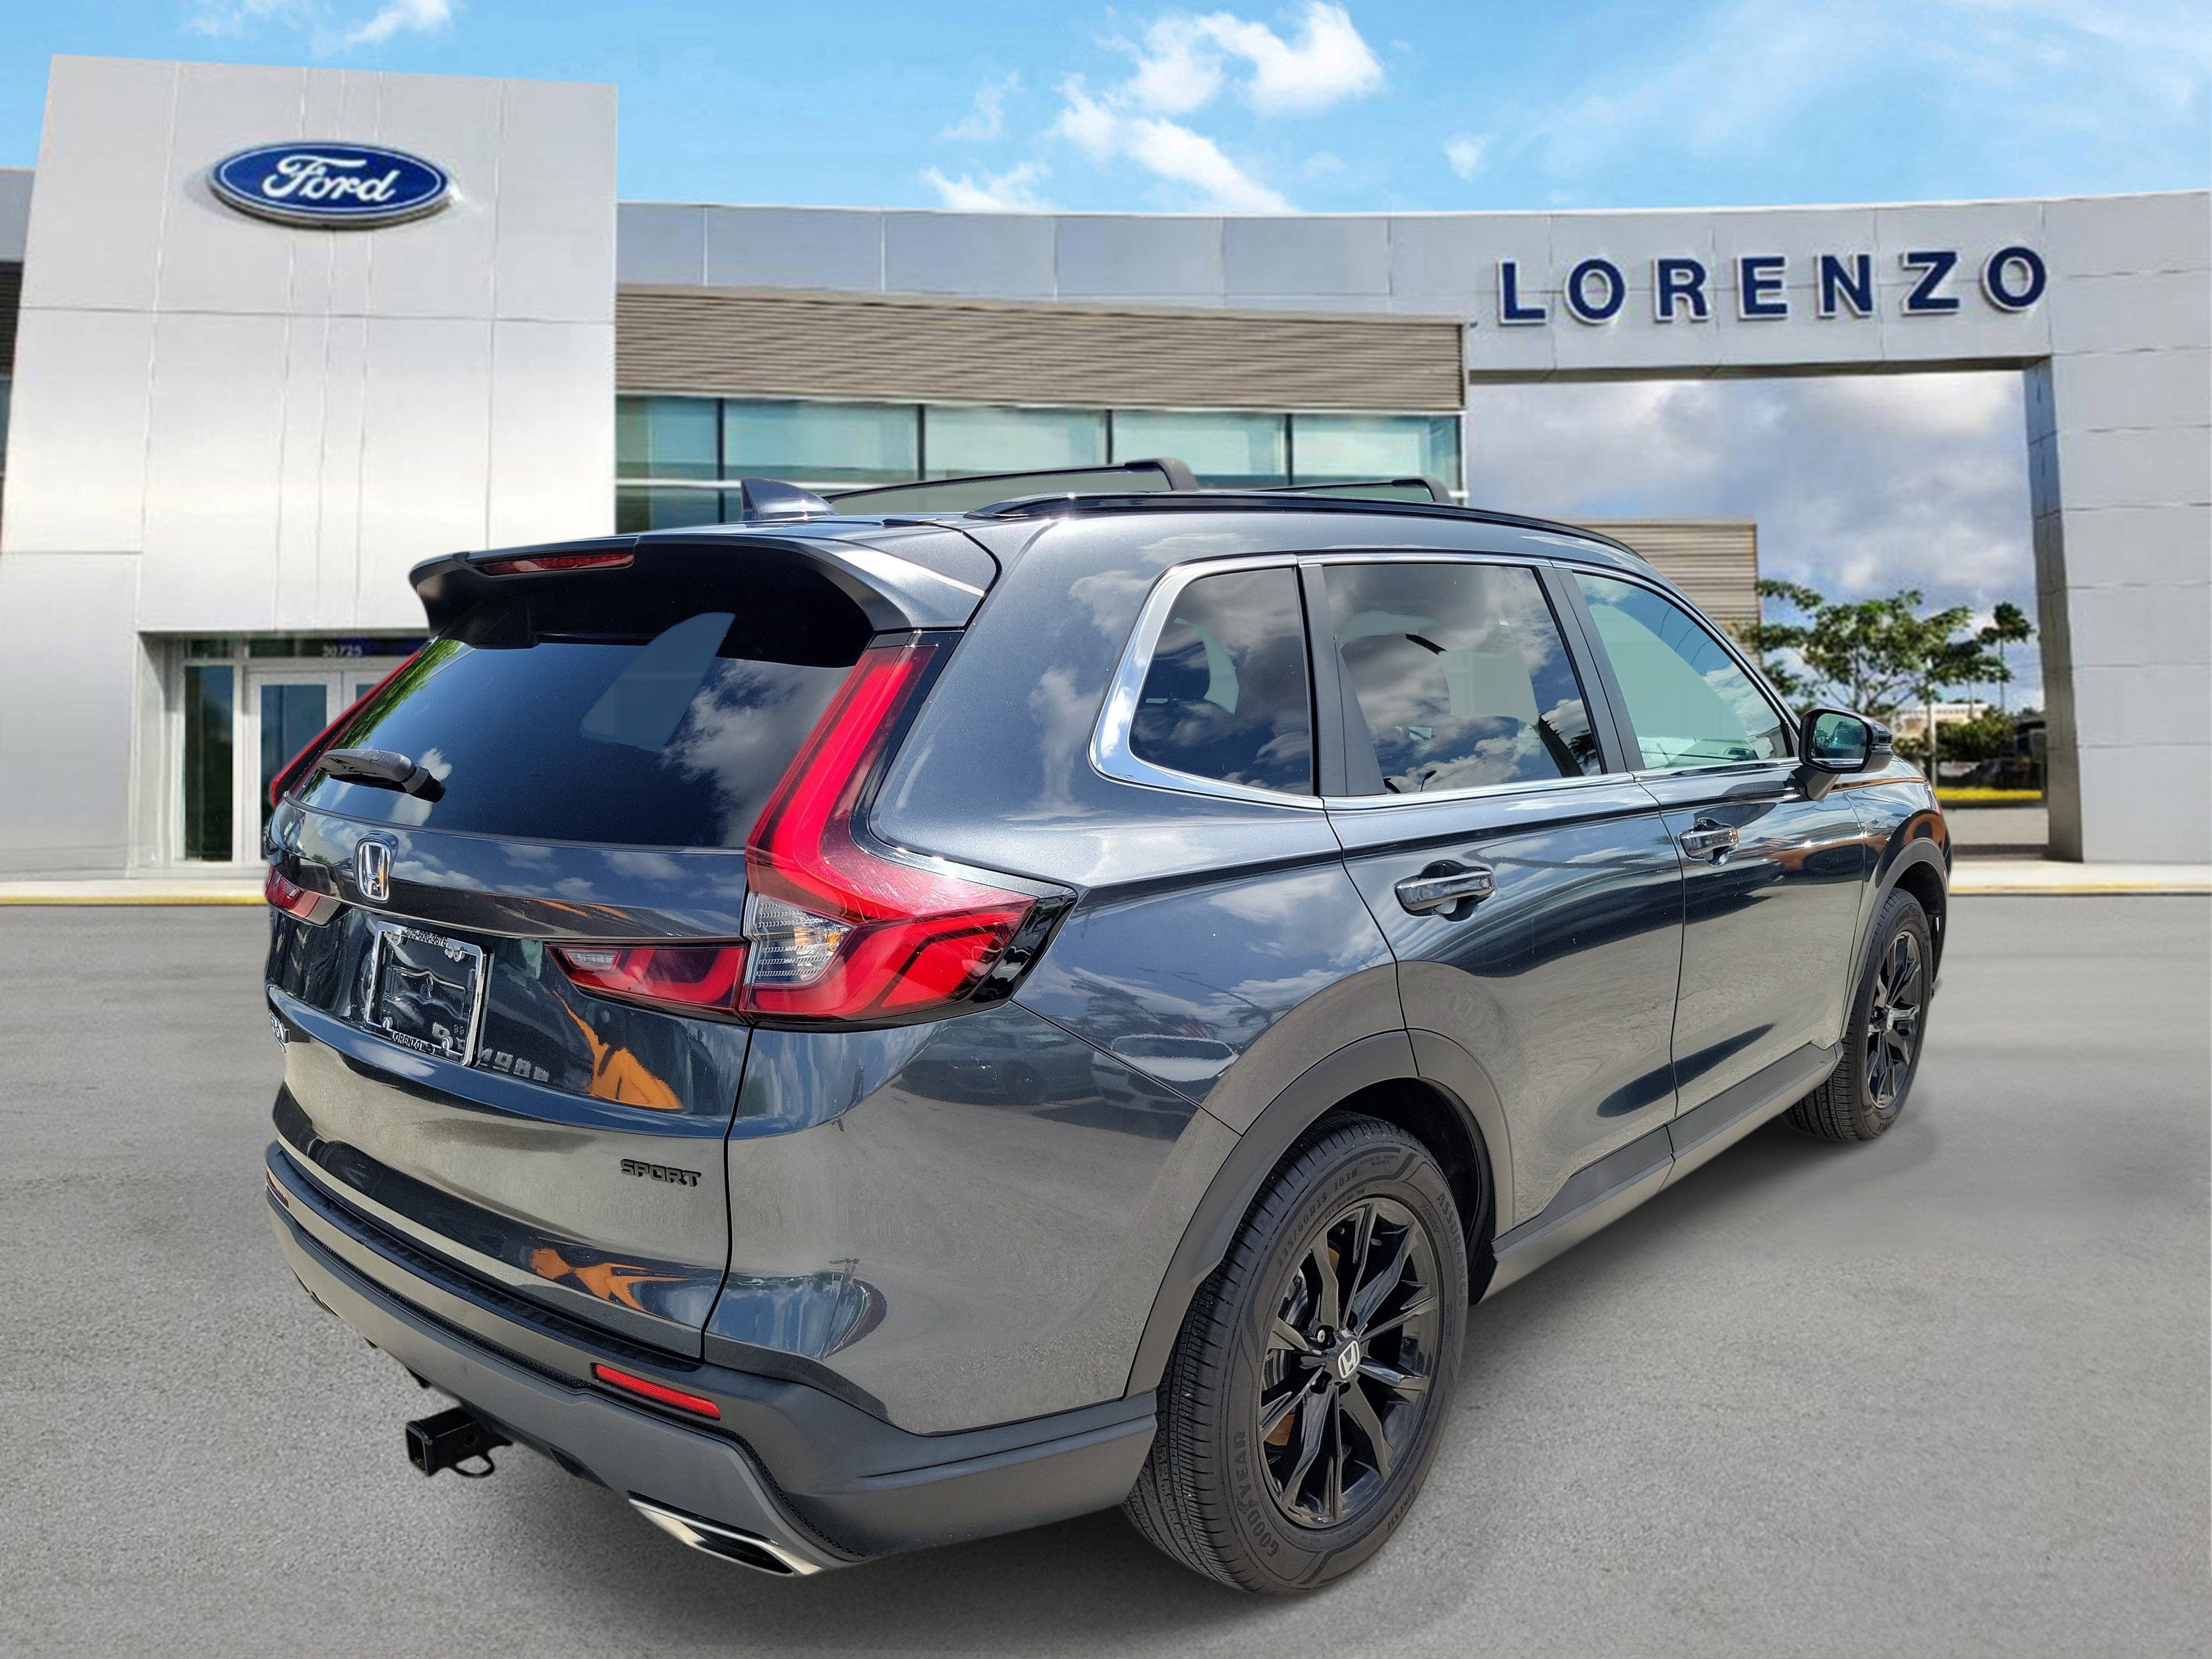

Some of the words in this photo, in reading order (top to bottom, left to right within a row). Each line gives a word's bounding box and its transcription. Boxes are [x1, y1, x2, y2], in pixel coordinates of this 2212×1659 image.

[262, 155, 400, 201] Ford
[1499, 247, 2047, 323] LORENZO
[392, 1030, 422, 1051] LORENZO
[620, 1158, 701, 1187] SPORT
[1234, 1431, 1279, 1557] GOODYEAR
